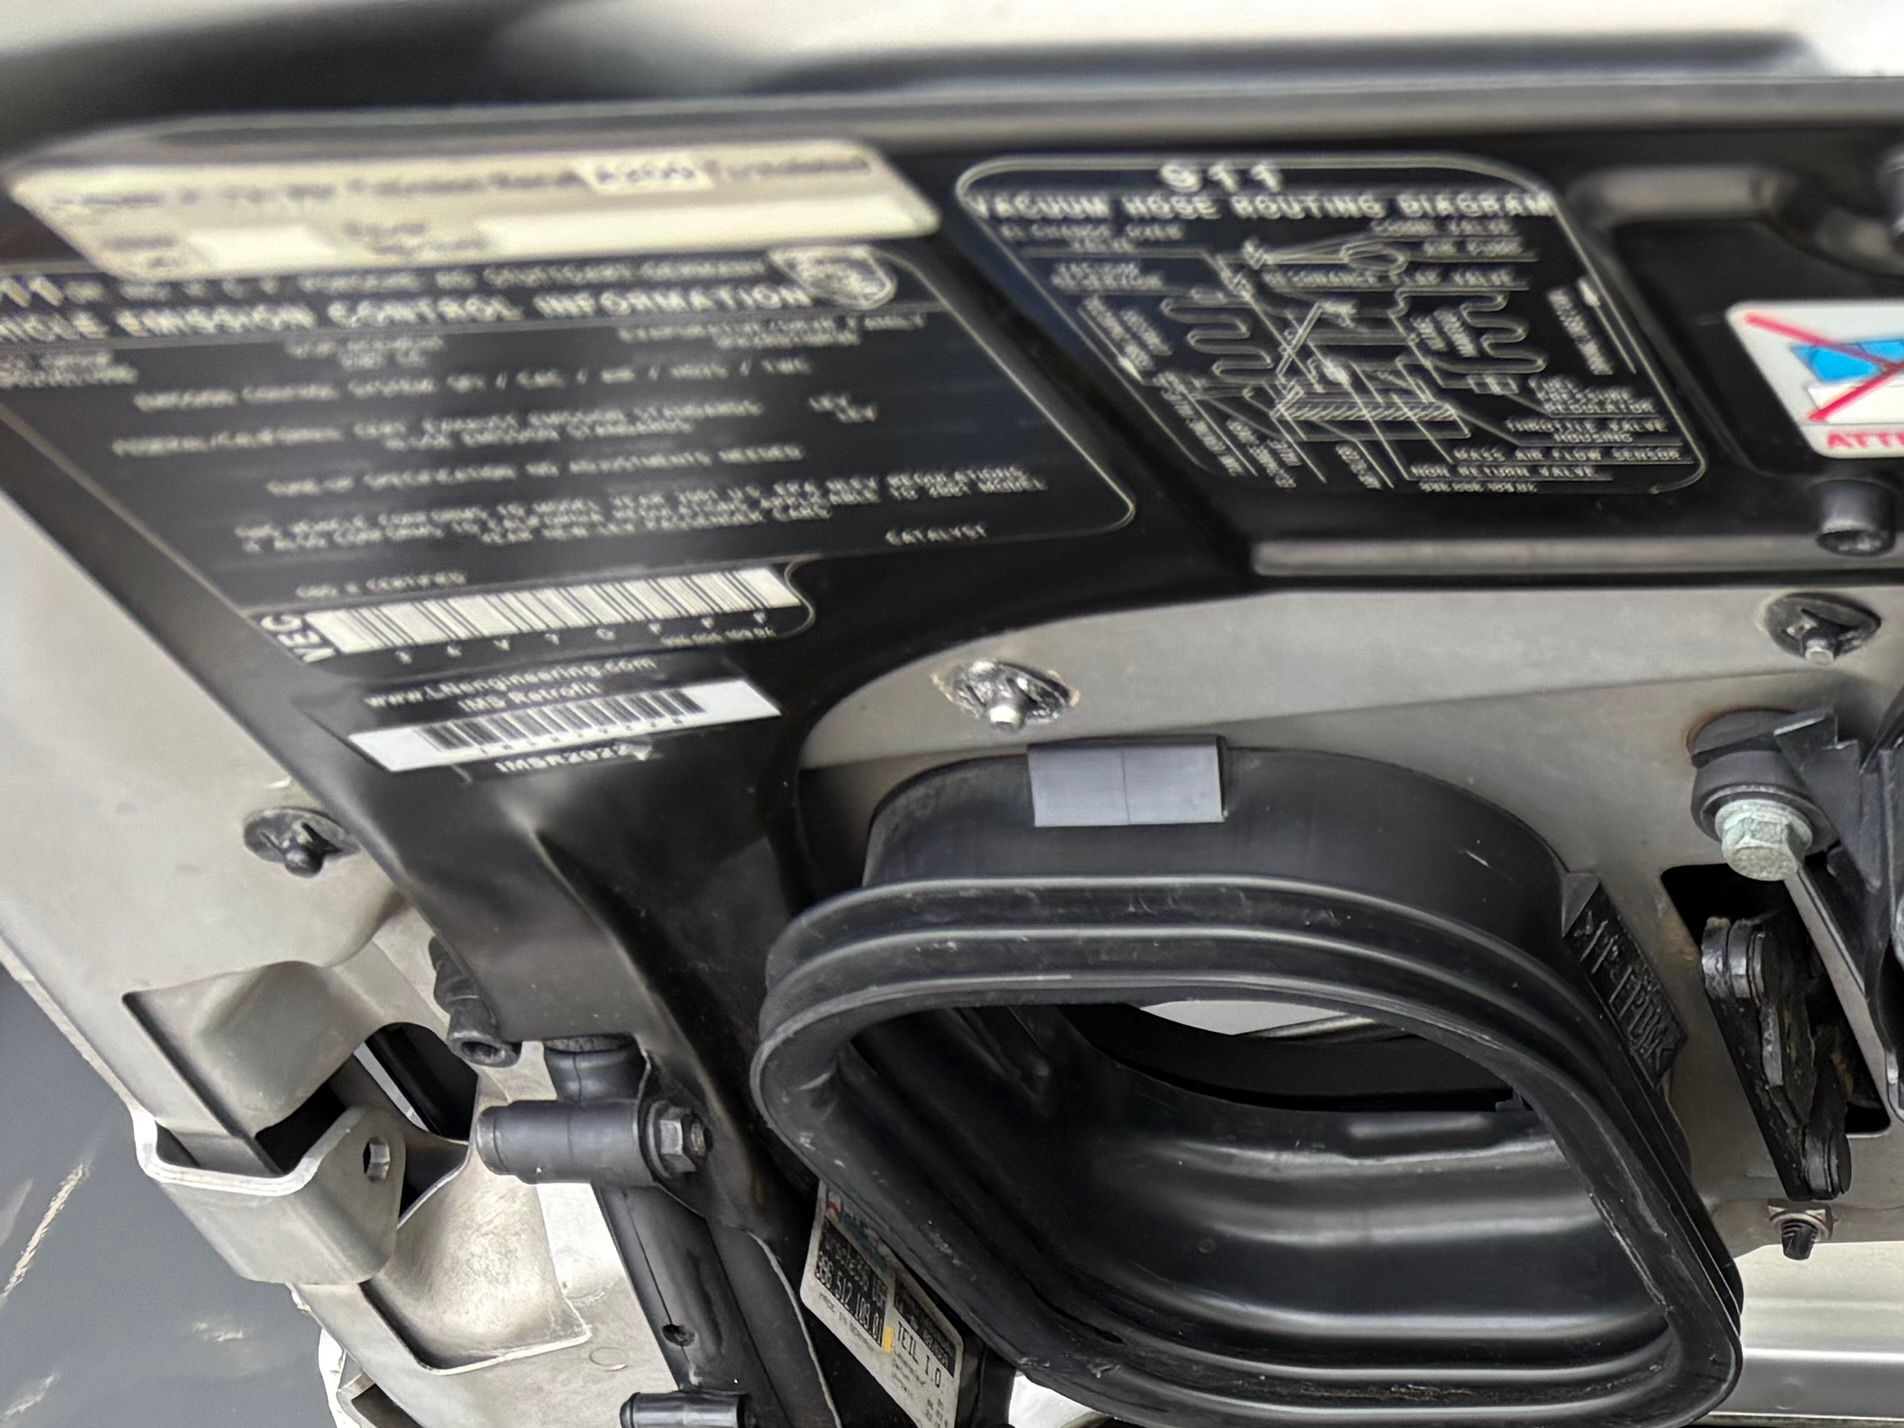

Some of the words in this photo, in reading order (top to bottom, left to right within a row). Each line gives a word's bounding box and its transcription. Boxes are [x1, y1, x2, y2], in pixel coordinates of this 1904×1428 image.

[1229, 192, 1387, 219] ROUTING
[1398, 191, 1555, 218] DIAGRAM
[532, 283, 813, 318] INFORMATION
